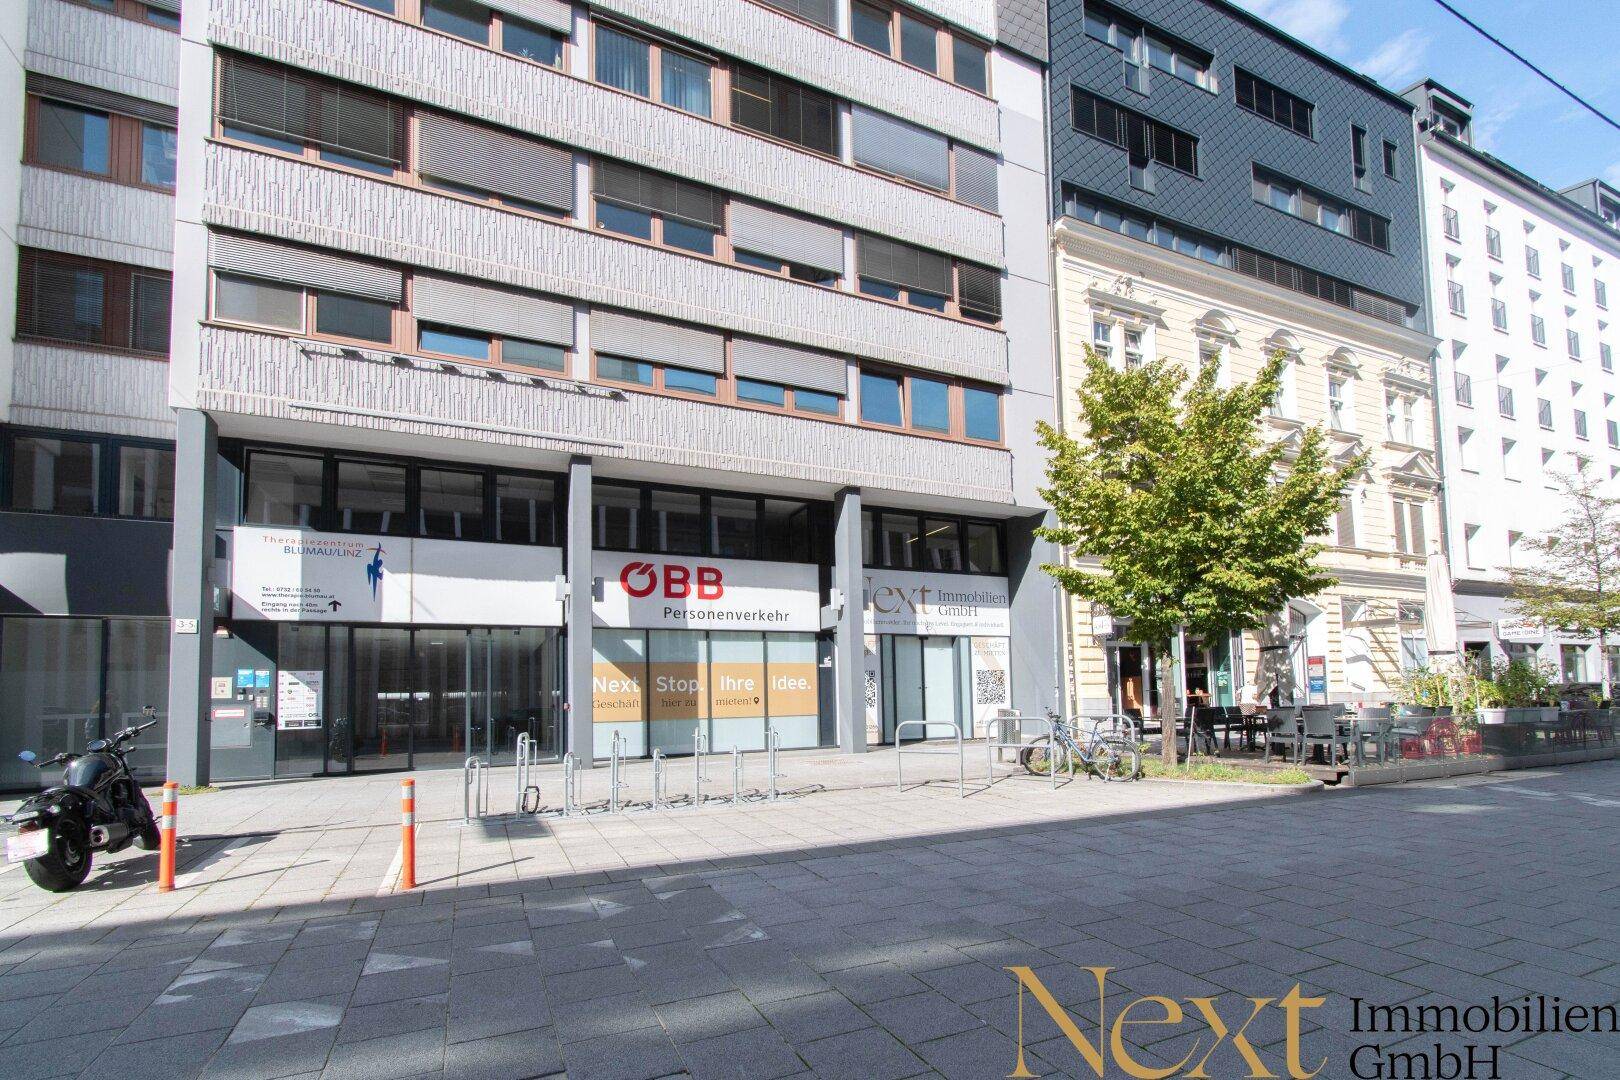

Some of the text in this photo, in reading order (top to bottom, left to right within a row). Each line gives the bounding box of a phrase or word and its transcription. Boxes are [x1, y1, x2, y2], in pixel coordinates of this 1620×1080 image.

[262, 535, 364, 548] Therapiezentrum
[284, 545, 362, 558] BLUMAU/LINZ
[619, 561, 724, 600] ÖBB
[938, 589, 1006, 604] Immobilien
[664, 606, 790, 622] Personenverkehr
[938, 605, 978, 616] GmbH
[592, 675, 812, 695] Next Stop. Ihre Idee.
[592, 698, 640, 709] Geschäft
[661, 698, 681, 707] hier
[716, 696, 752, 706] mieten!
